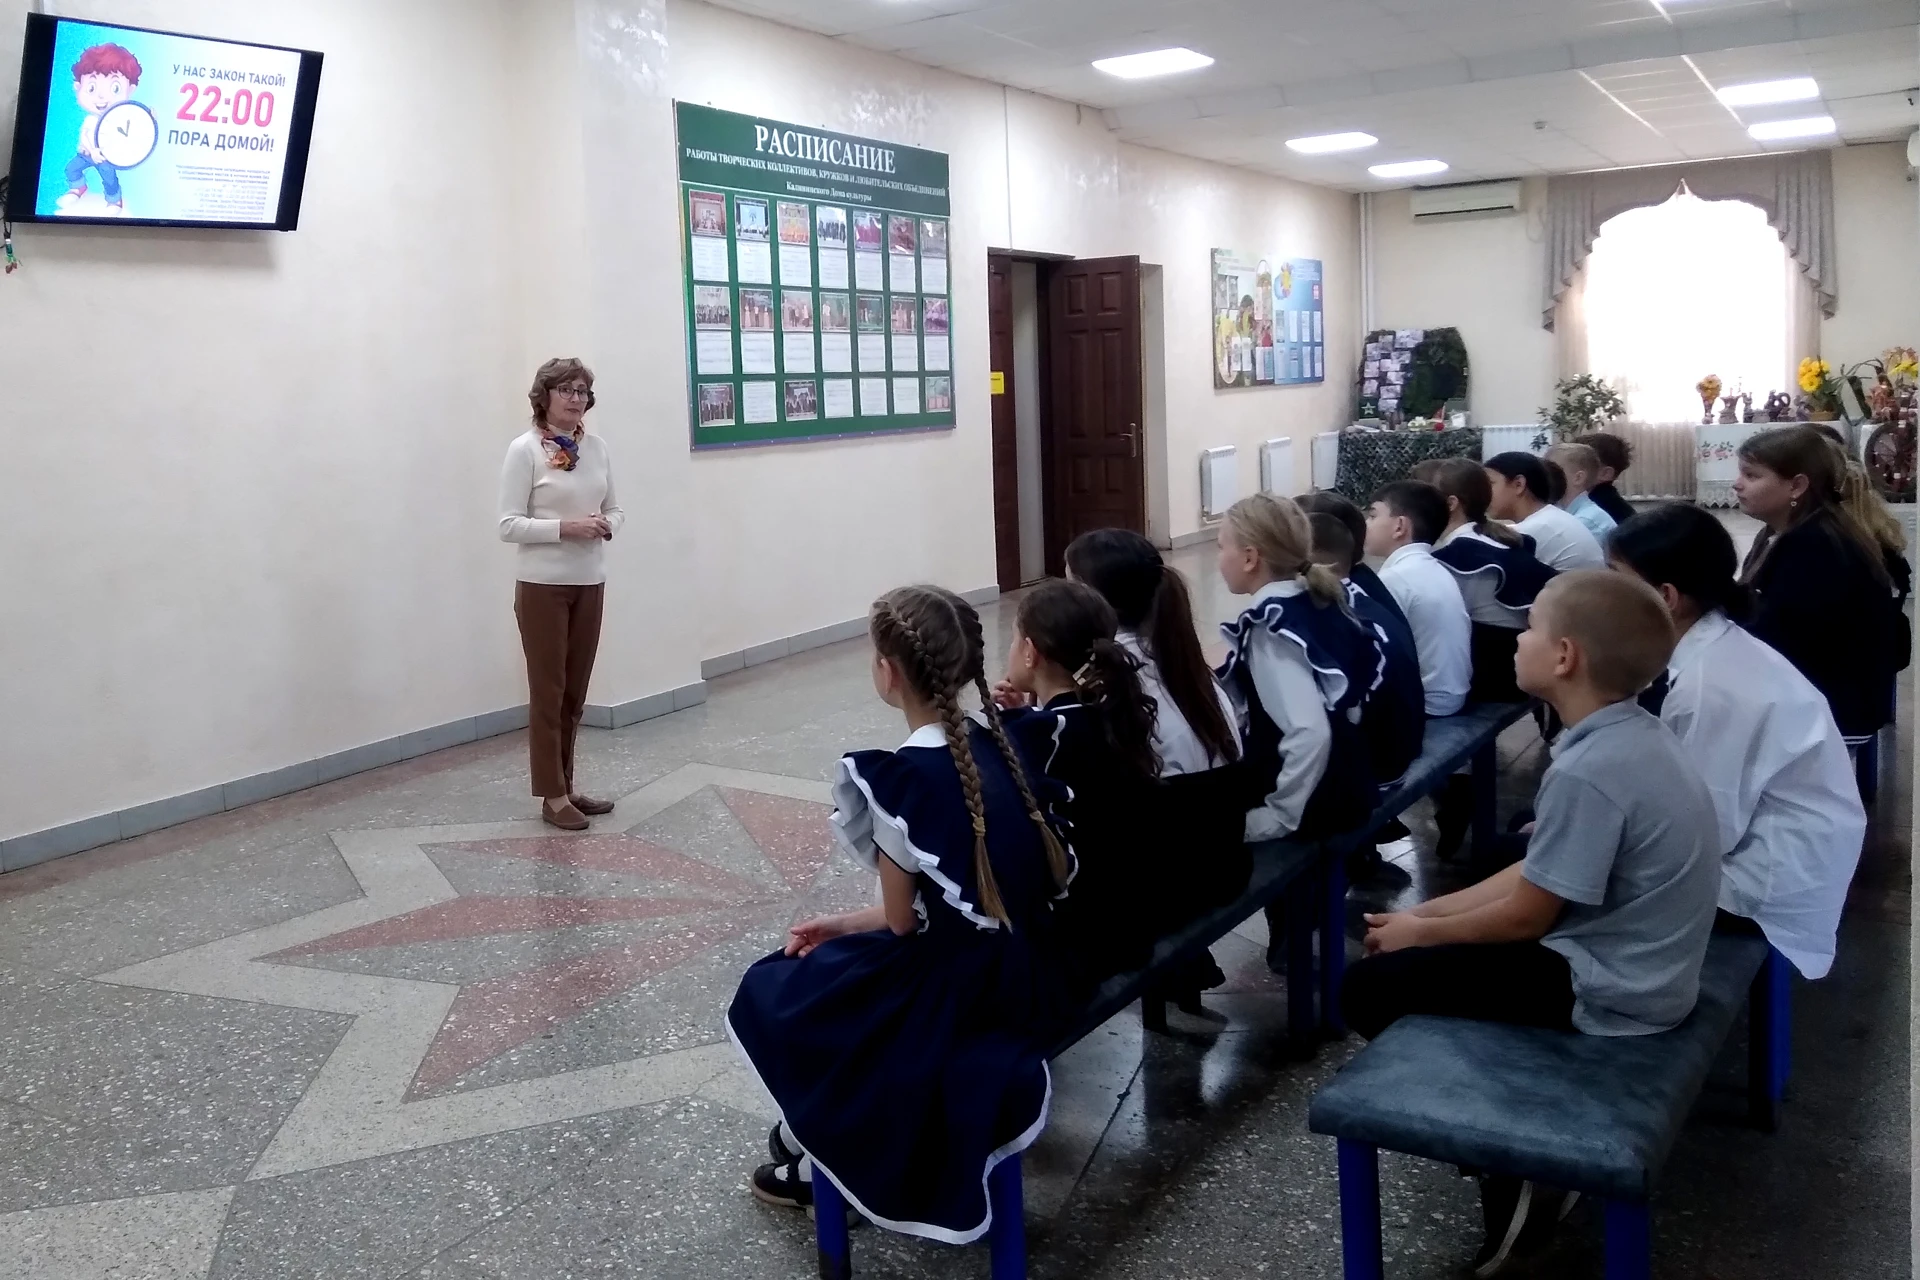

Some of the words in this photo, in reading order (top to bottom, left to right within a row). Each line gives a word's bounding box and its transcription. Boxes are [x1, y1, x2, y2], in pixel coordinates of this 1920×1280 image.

[173, 64, 180, 75] У
[183, 65, 206, 78] НАС
[209, 68, 246, 82] ЗАКОН
[249, 72, 286, 87] ТАКОЙ!
[176, 82, 275, 128] 22:00
[168, 130, 210, 147] ПОРА
[214, 133, 274, 152] ДОМОЙ!
[754, 124, 896, 174] РАСПИСАНИЕ
[685, 147, 718, 162] РАБОТЫ
[718, 153, 767, 170] ТВОРЧЕСКИХ
[767, 161, 819, 178] КОЛЛЕКТИВОВ,
[819, 170, 849, 183] КРУЖКОВ
[850, 174, 855, 183] И
[854, 175, 904, 191] ЛЮБИТЕЛЬСКИХ
[904, 183, 946, 197] ОБЪЕДИНЕНИЙ
[786, 181, 830, 195] Калининского
[830, 187, 846, 198] Дома
[846, 191, 872, 202] культуры
